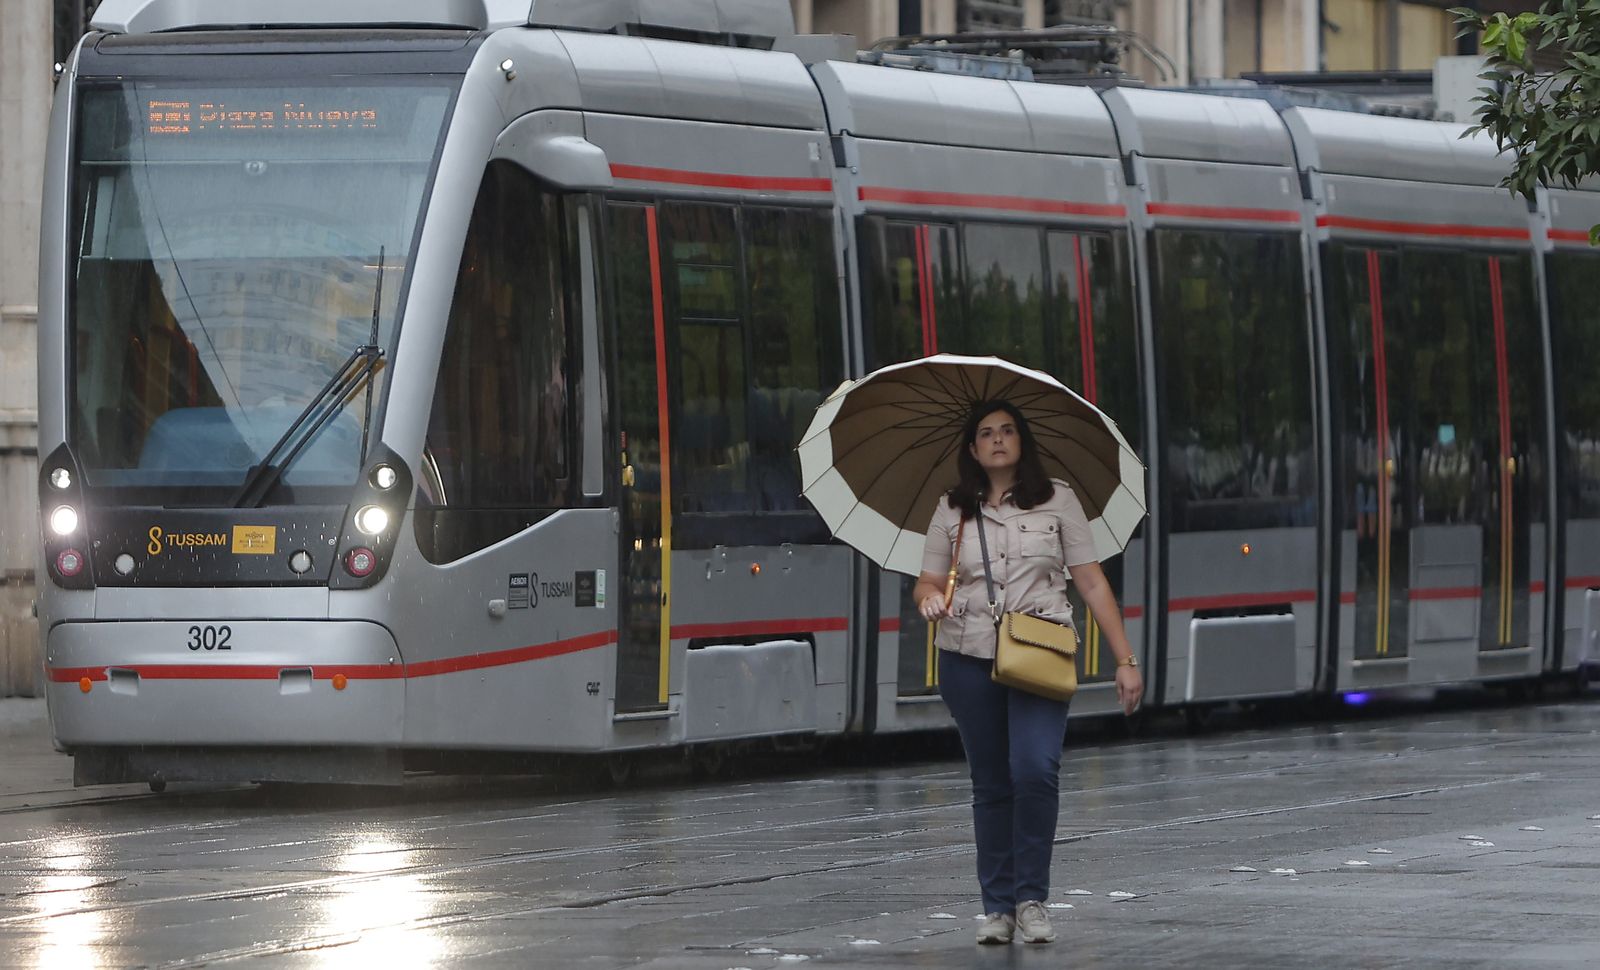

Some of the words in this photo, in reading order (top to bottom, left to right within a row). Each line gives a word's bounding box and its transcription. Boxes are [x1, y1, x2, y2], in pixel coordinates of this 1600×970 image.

[167, 533, 226, 546] TUSSAM
[541, 582, 573, 598] TUSSAM
[187, 625, 232, 651] 302
